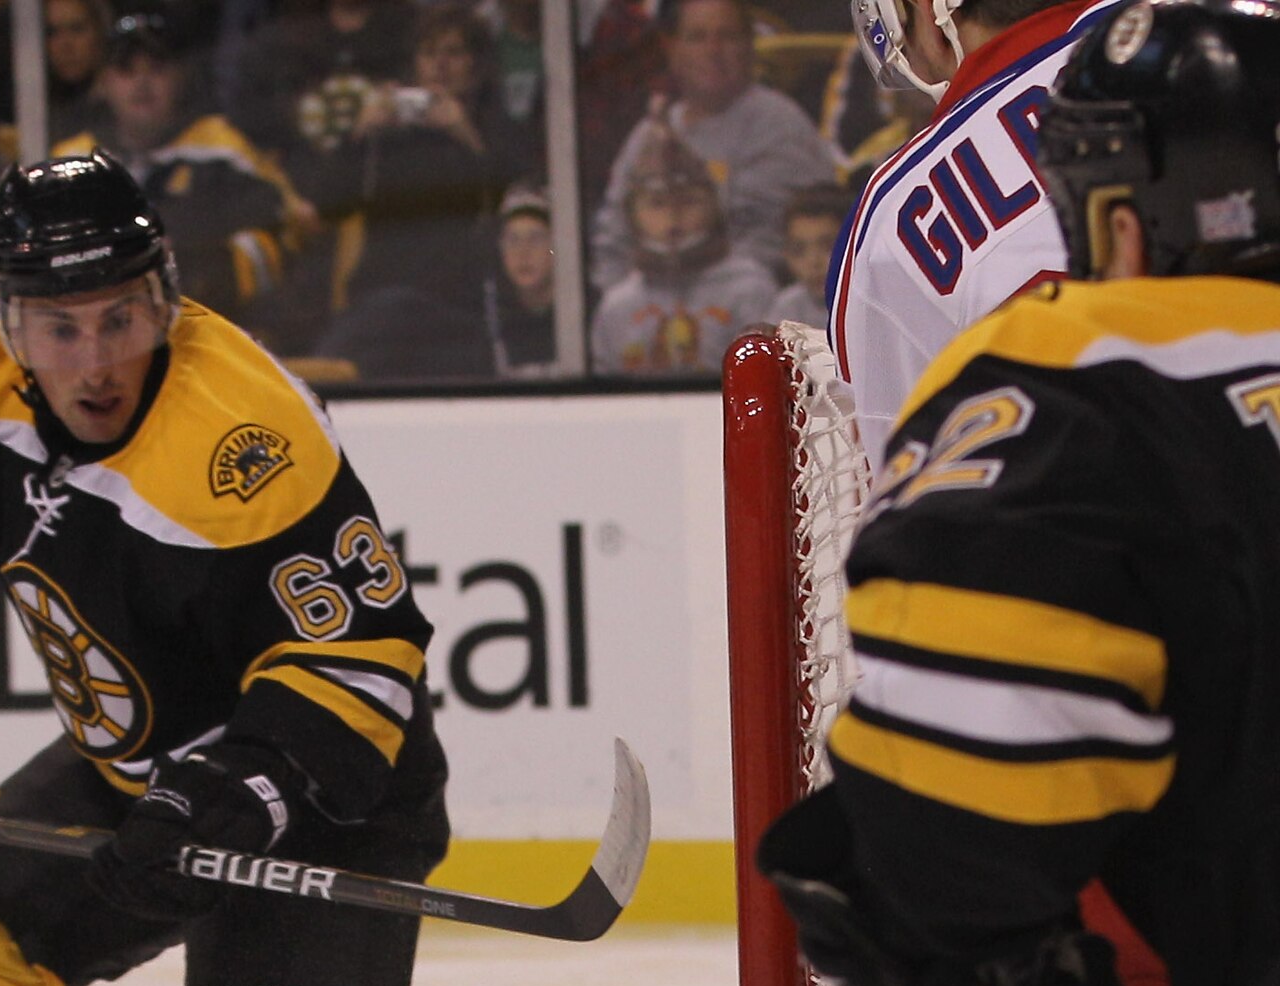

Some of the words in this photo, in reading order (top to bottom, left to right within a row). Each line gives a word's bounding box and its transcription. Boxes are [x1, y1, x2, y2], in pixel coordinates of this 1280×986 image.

[217, 429, 281, 487] BRUINS
[270, 515, 409, 642] 63
[177, 845, 337, 901] AUER
